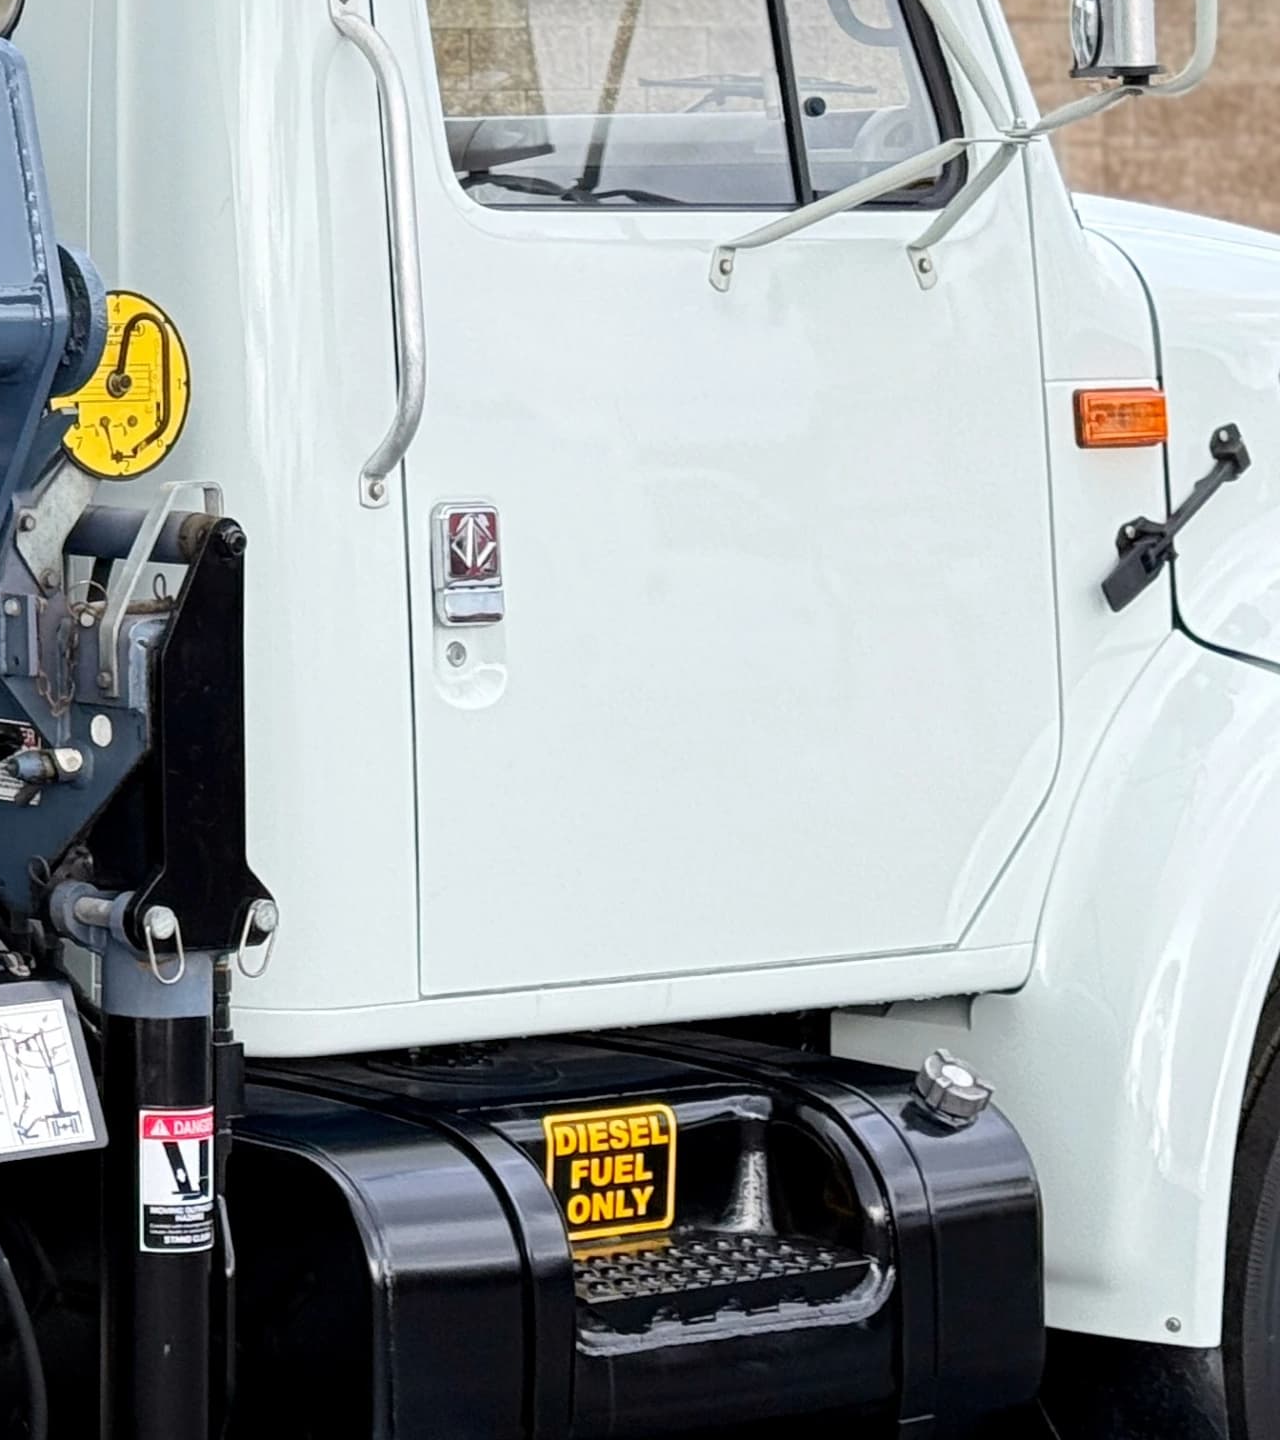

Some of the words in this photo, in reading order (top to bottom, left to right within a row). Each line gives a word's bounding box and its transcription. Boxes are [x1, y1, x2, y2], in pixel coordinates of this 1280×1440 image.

[174, 1118, 213, 1136] DANGE
[554, 1115, 668, 1156] DIESEL
[571, 1152, 654, 1189] FUEL
[567, 1186, 655, 1224] ONLY
